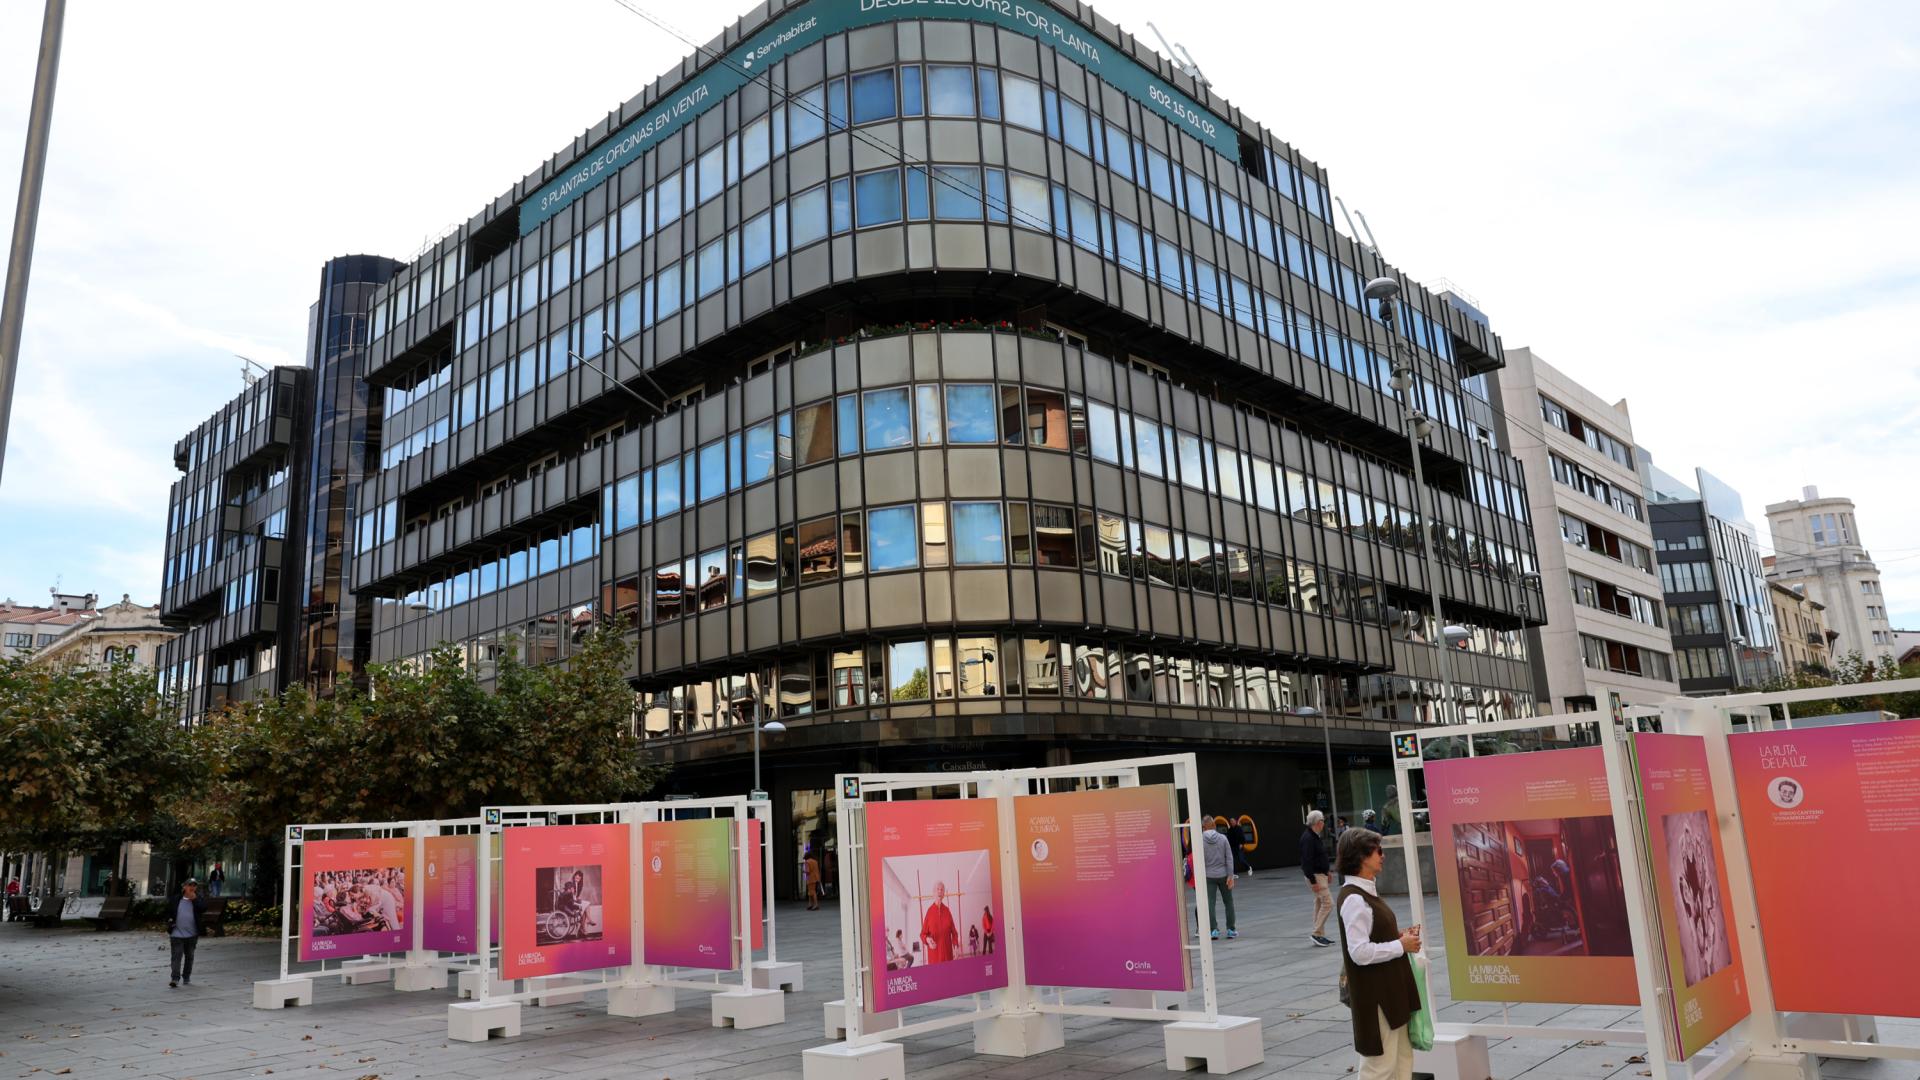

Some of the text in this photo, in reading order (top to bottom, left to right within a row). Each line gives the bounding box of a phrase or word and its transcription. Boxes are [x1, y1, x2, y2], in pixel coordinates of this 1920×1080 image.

[757, 16, 817, 59] Servihabitat
[935, 0, 1101, 64] 0m2 POR PLANTA
[1149, 85, 1216, 138] 902 15 01 02
[541, 84, 709, 211] 3 PLANTAS DE OFICINAS EN VENTA
[1760, 744, 1797, 757] LA RUTA
[942, 760, 986, 771] CaixaBank
[1762, 756, 1808, 769] DE LA LUZ
[1453, 797, 1480, 805] contigo
[1468, 965, 1511, 974] LA MIRADA
[1470, 974, 1520, 984] DEL PACIENTE
